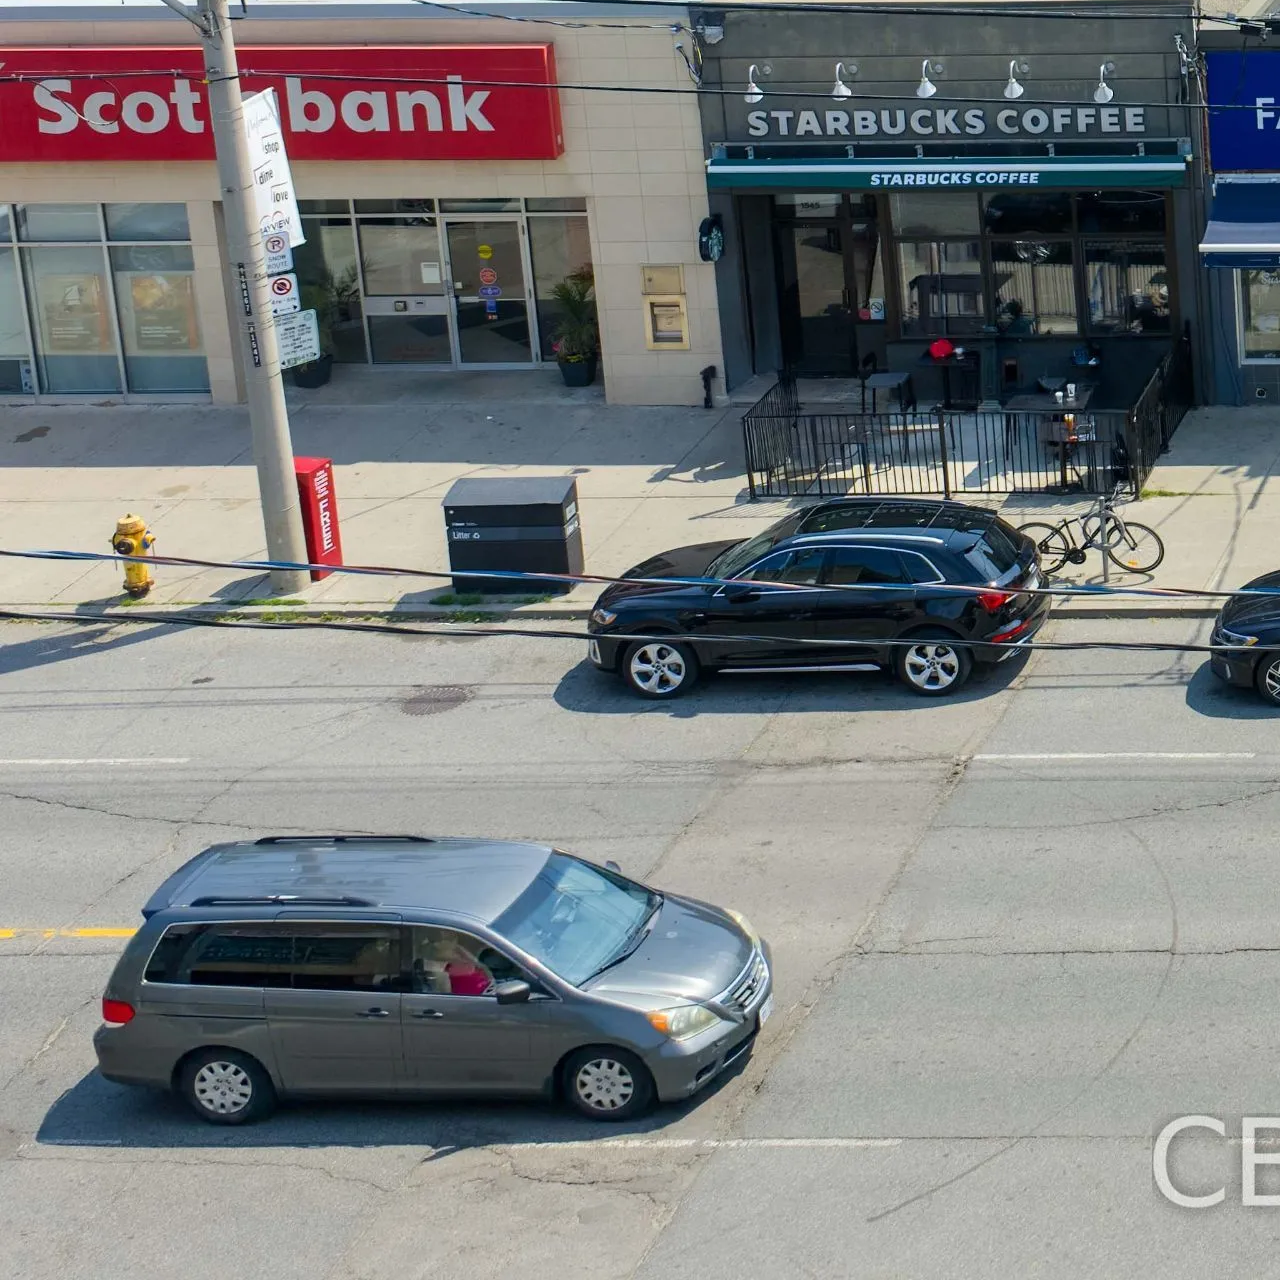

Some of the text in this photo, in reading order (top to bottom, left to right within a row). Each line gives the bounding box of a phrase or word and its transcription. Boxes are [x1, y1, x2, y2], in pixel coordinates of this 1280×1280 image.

[33, 75, 496, 135] Scotbank
[746, 106, 1146, 137] STARBUCKS COFFEE
[264, 141, 280, 155] shop
[258, 169, 273, 185] dine
[870, 172, 1040, 186] STARBUCKS COFFEE
[273, 190, 288, 203] love
[319, 498, 334, 551] FREE
[452, 531, 471, 539] Litter
